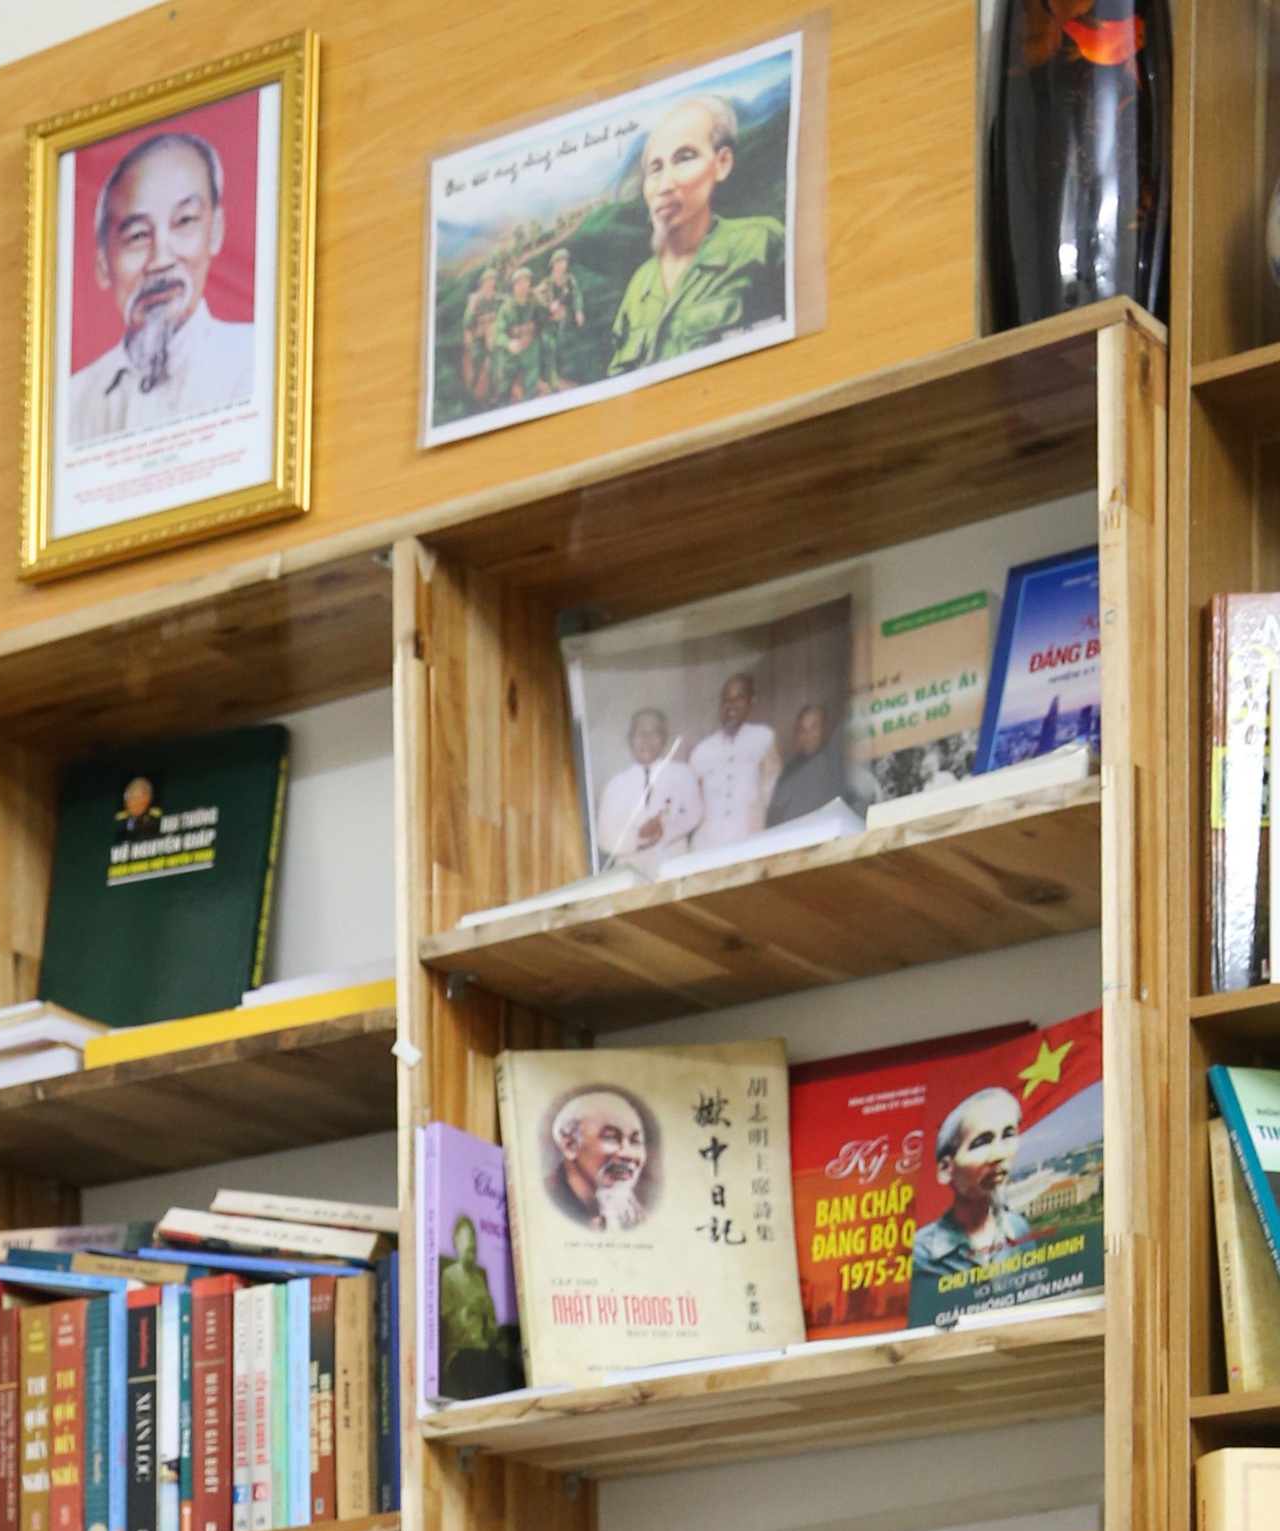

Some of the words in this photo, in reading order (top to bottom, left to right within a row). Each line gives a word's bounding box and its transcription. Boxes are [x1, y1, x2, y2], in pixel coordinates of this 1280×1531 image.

[815, 1194, 857, 1228] BAN
[860, 1178, 914, 1220] CHẤP
[811, 1225, 866, 1263] ĐẢNG
[869, 1216, 899, 1257] BỘ
[1022, 1243, 1047, 1269] CHÍ
[1047, 1234, 1085, 1260] MINH
[1051, 1271, 1084, 1293] NAM
[551, 1287, 593, 1330] NHẬT
[597, 1287, 619, 1326] KÝ
[622, 1294, 674, 1327] TRONG
[677, 1289, 700, 1327] TÙ
